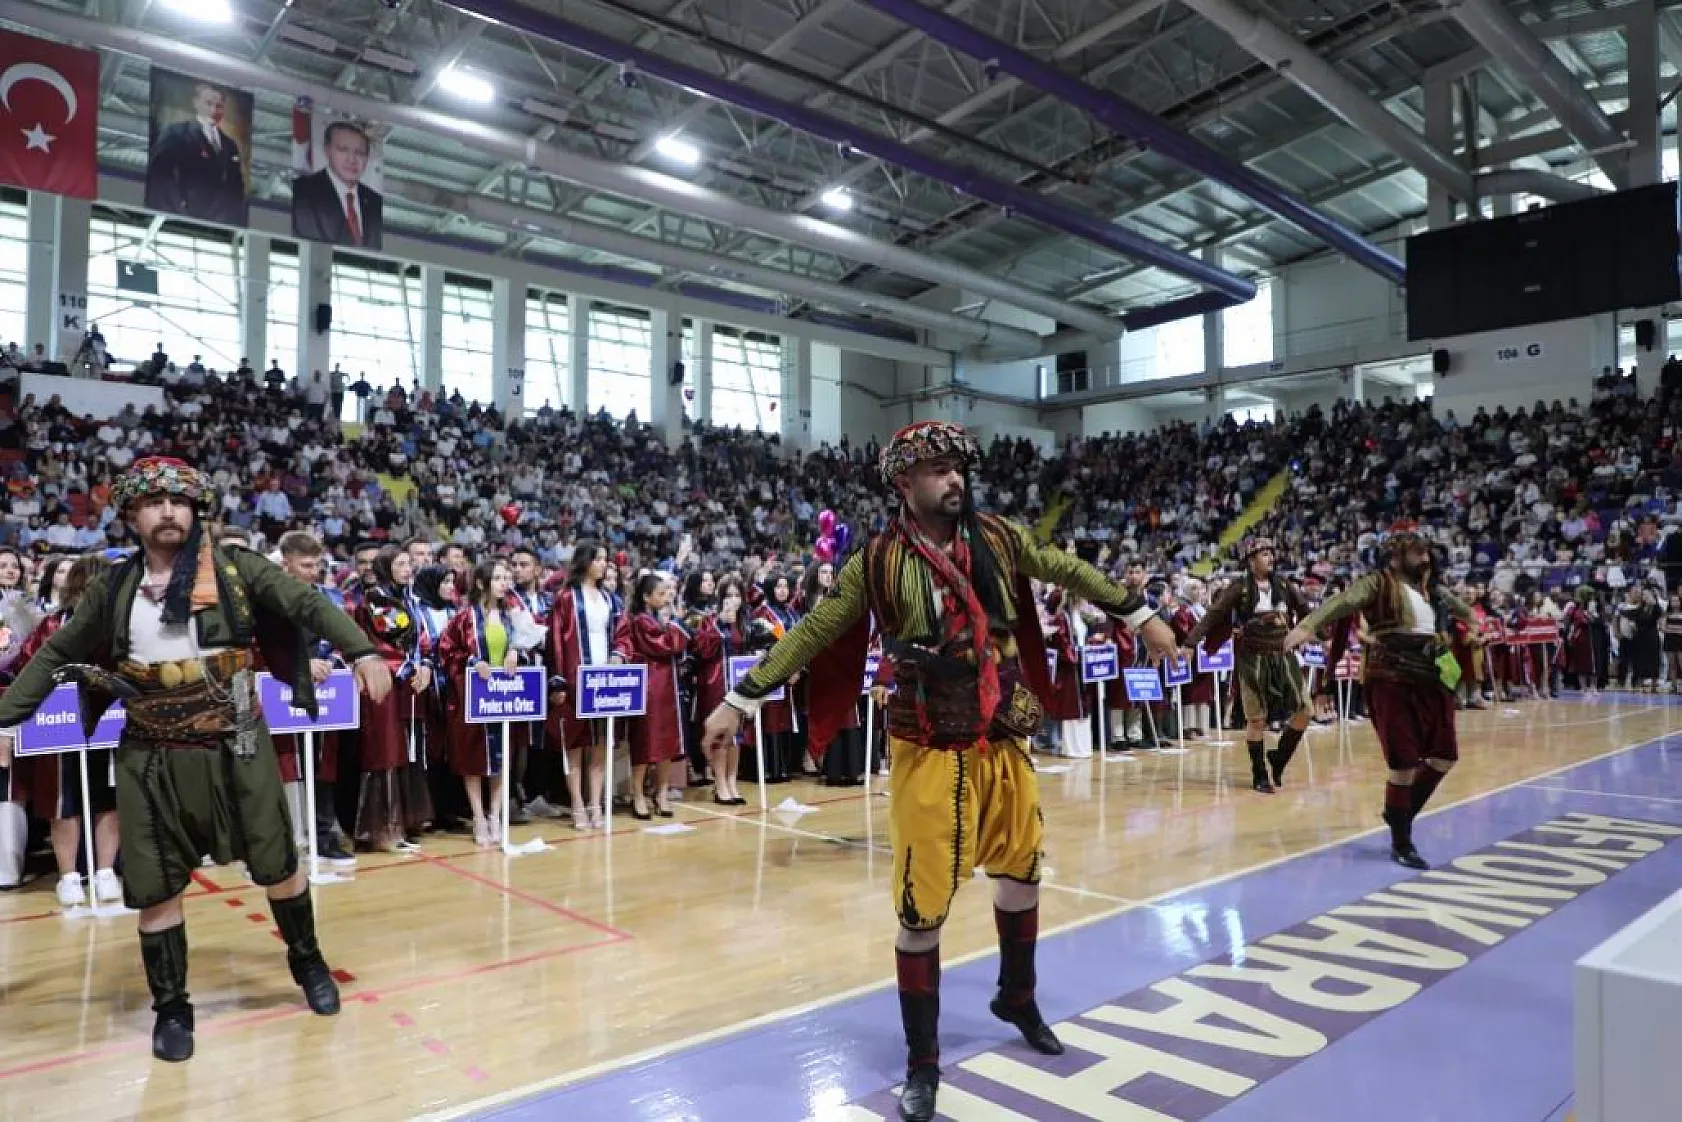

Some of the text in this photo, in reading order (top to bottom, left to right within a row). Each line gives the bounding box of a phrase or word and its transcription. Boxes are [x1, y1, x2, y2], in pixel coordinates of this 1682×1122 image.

[60, 293, 87, 309] 110
[64, 314, 80, 329] K
[1527, 344, 1541, 357] G
[478, 697, 535, 715] Protez ve Ortez
[36, 710, 76, 726] Hasta
